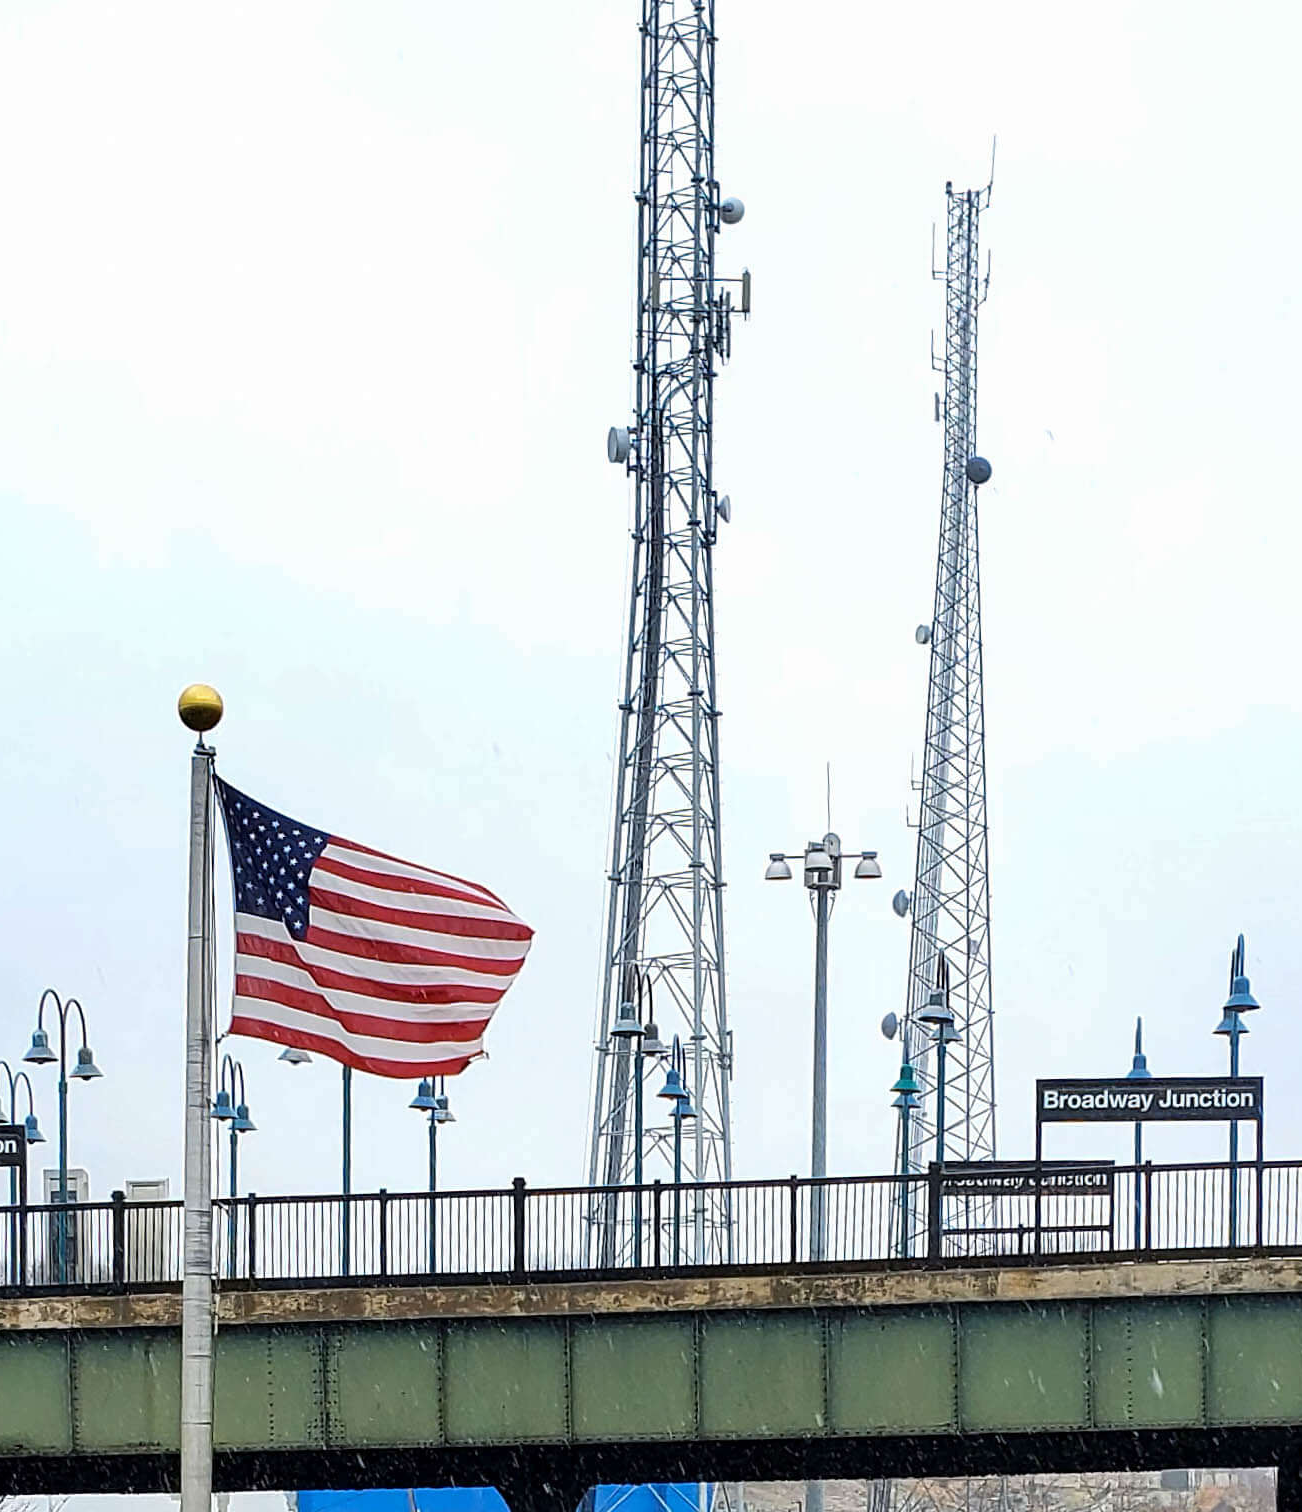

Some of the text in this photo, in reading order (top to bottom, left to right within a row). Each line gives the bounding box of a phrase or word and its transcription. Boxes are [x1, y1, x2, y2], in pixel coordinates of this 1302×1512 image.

[1042, 1088, 1254, 1113] Broadway Junction
[1028, 1173, 1108, 1187] unction
